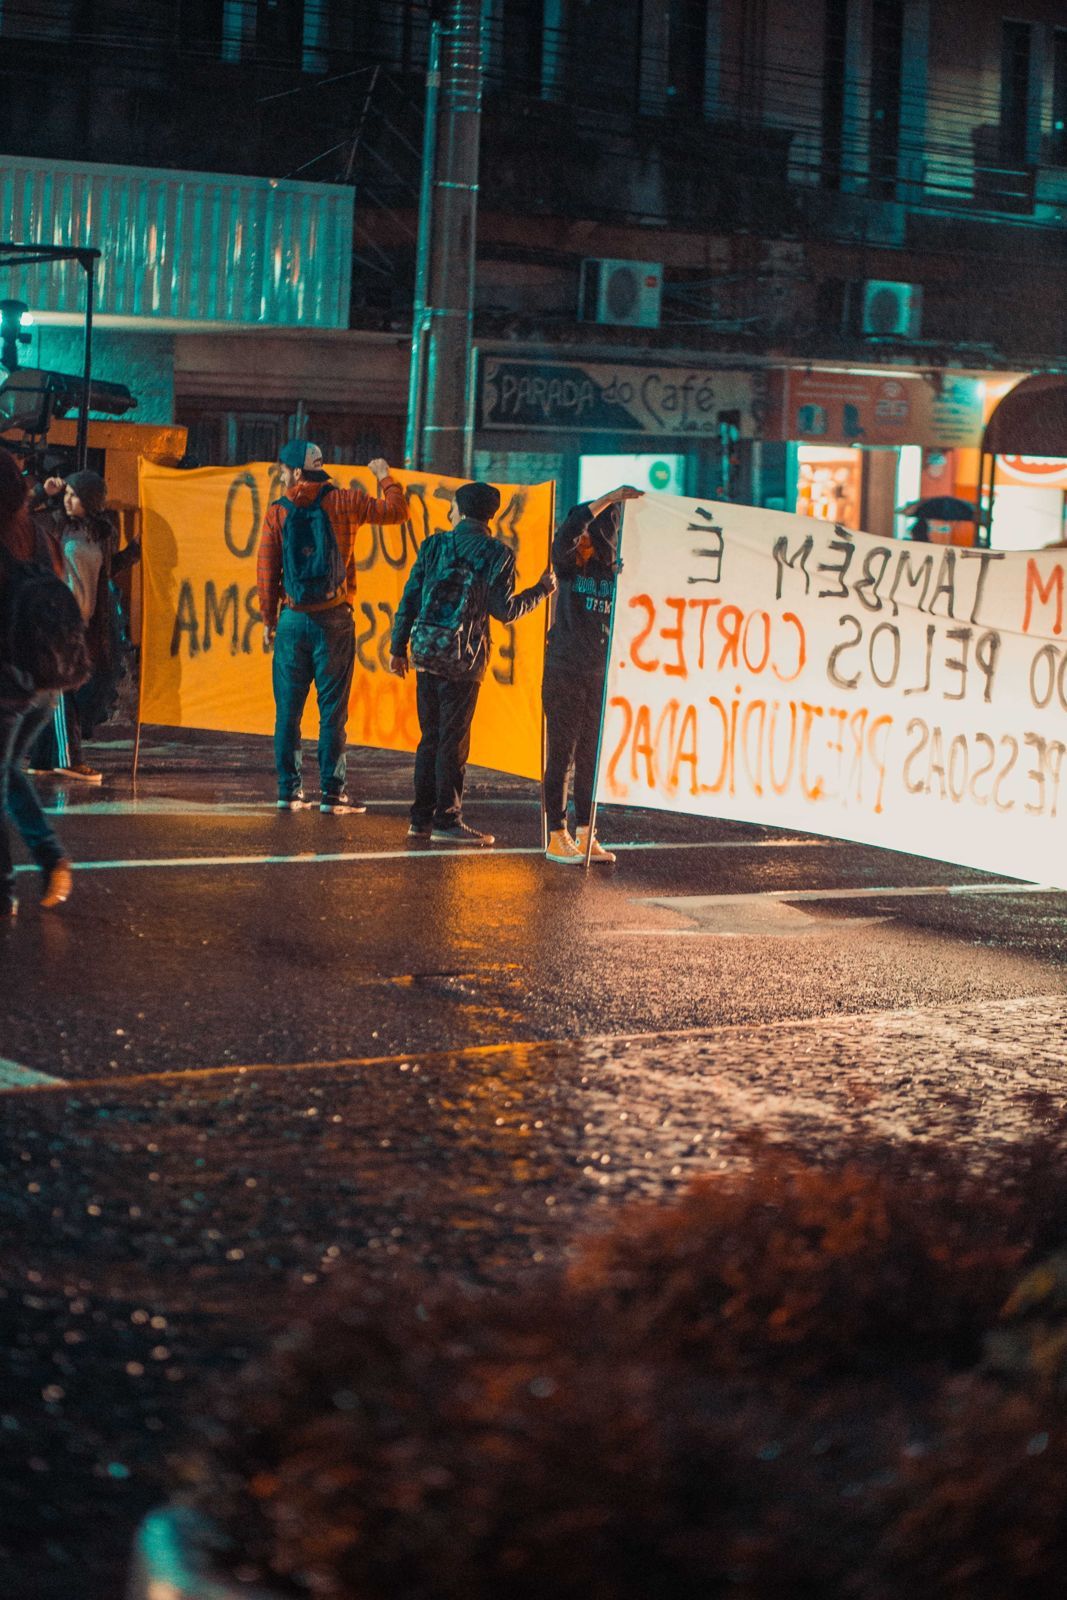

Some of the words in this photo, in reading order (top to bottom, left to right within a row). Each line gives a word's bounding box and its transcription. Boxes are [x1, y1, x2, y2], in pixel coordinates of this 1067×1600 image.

[500, 374, 595, 416] PARADA
[602, 372, 634, 405] do
[640, 373, 717, 431] Café
